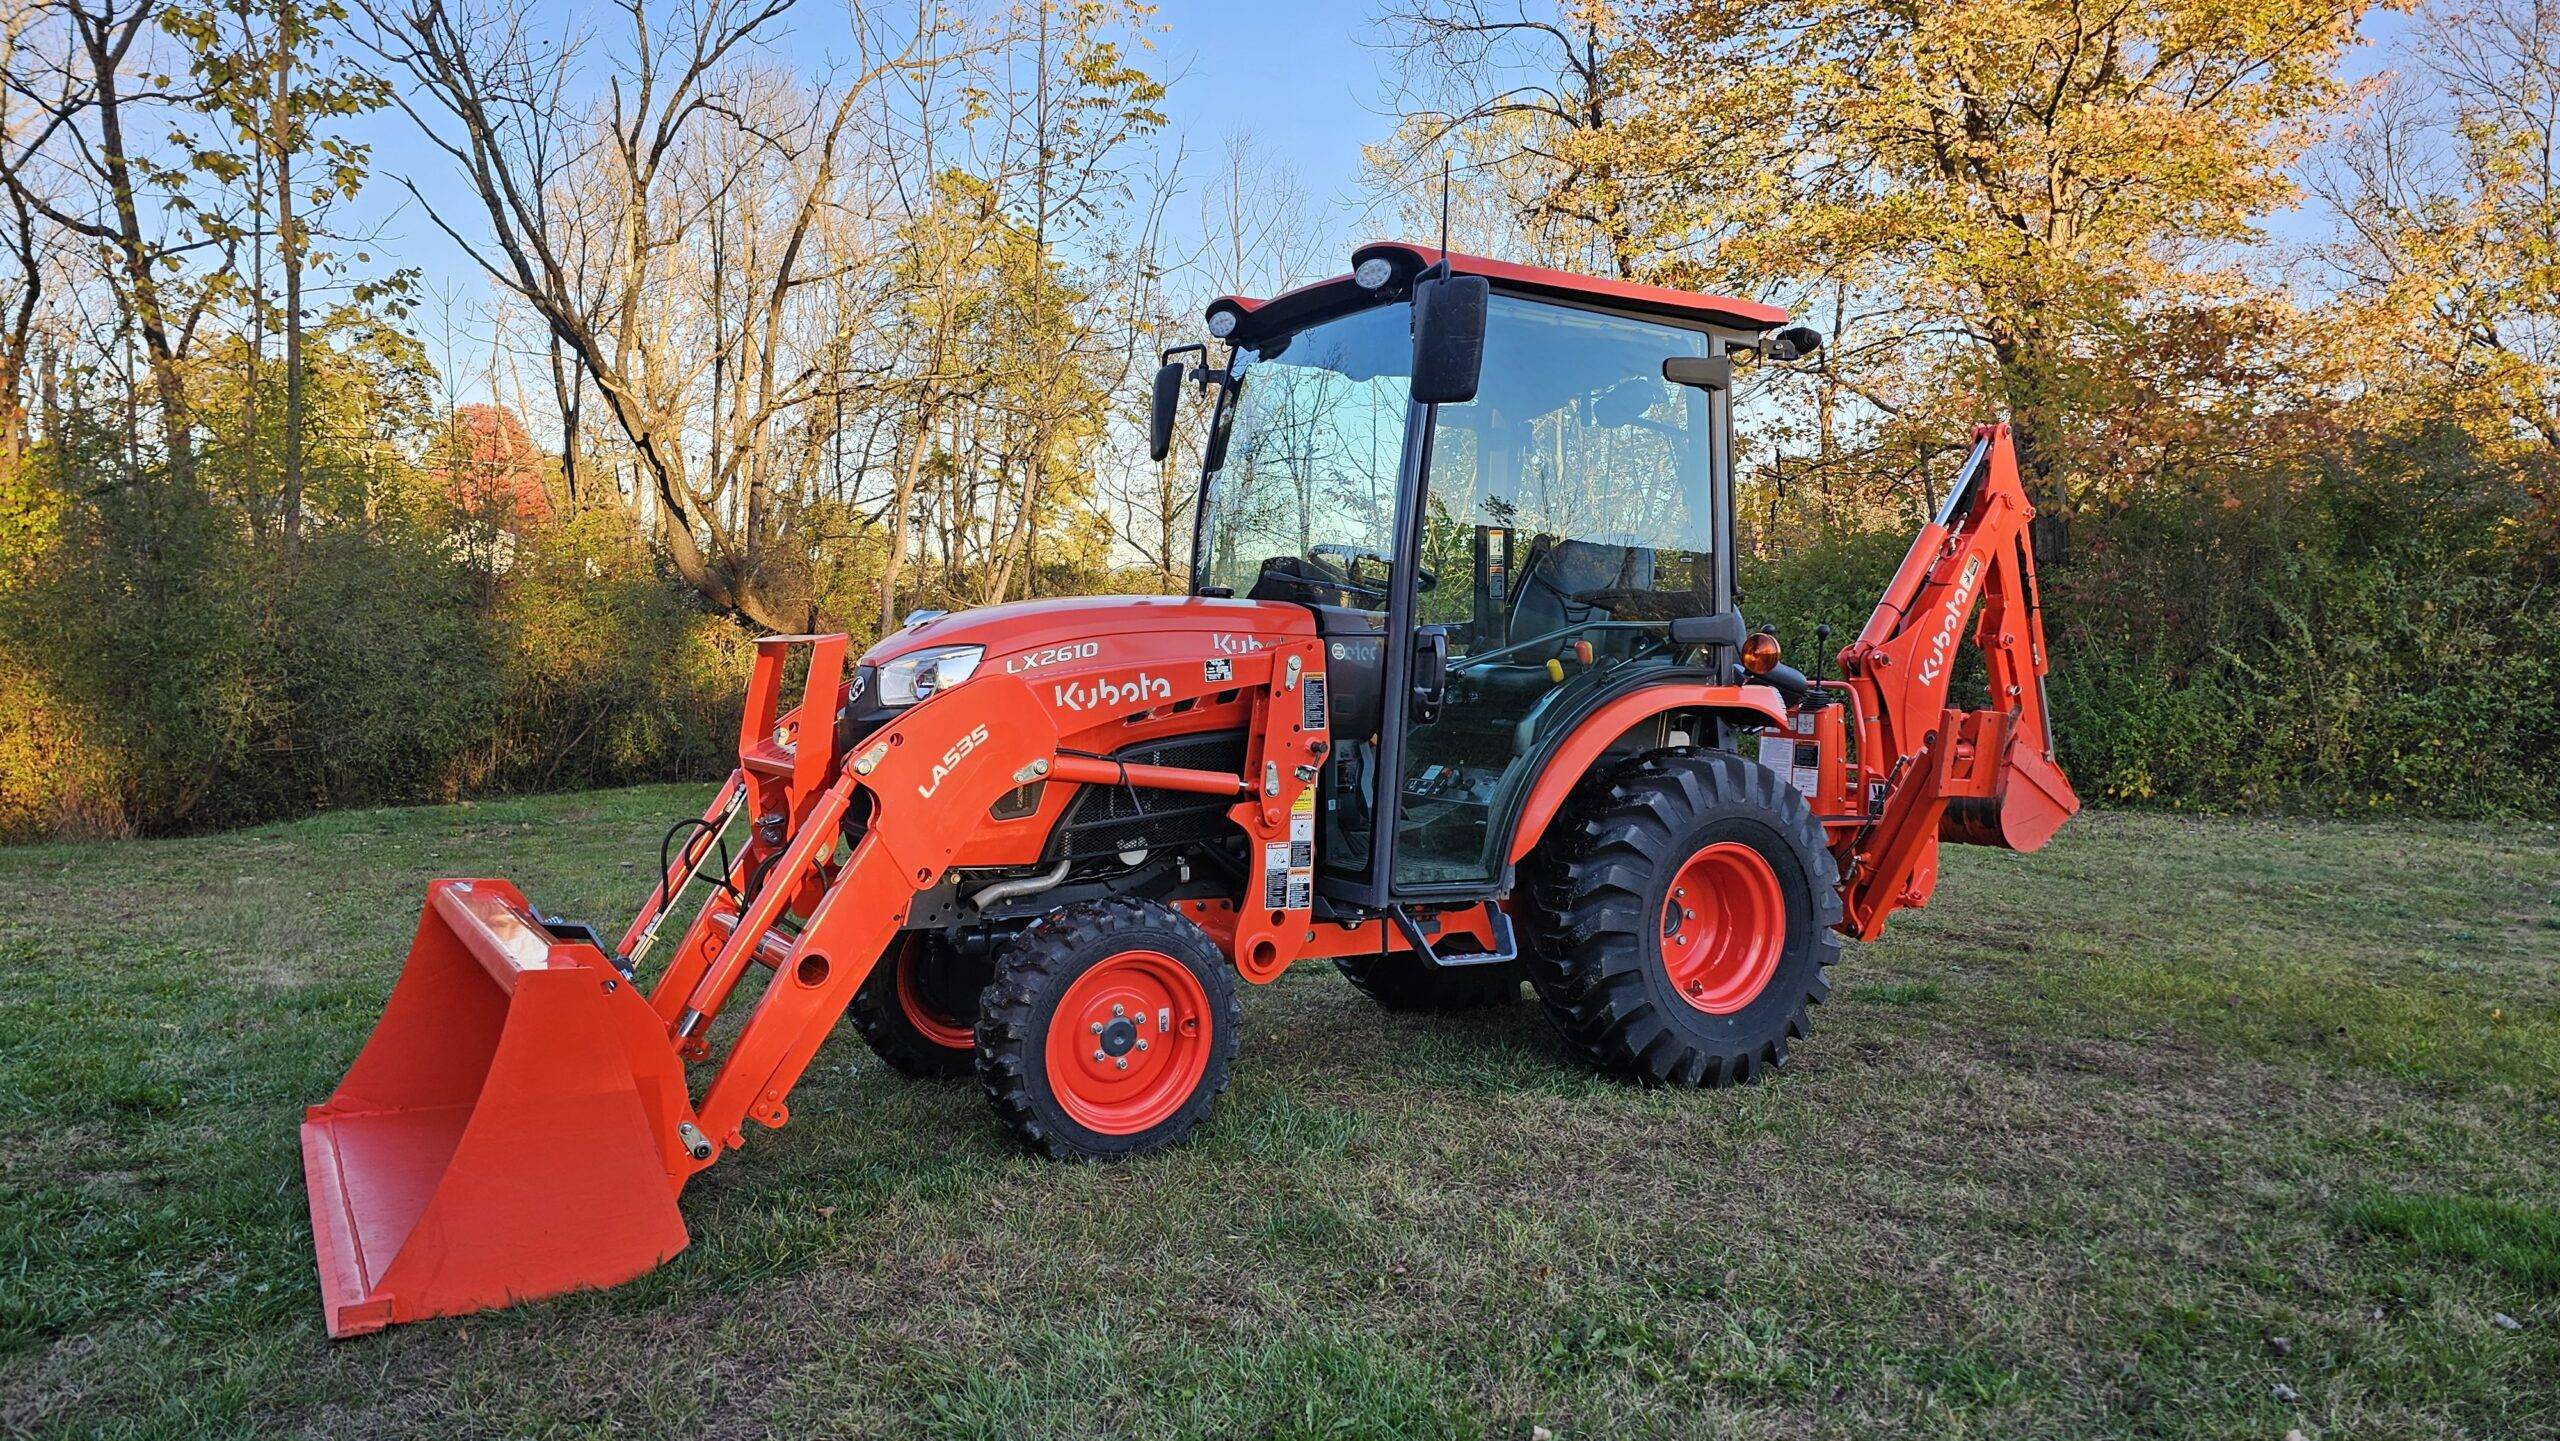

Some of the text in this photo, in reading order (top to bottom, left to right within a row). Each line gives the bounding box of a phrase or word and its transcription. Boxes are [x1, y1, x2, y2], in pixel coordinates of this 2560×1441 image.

[1213, 632, 1284, 655] Kub
[1918, 588, 1968, 686] Kubota
[1006, 642, 1098, 675] LX2610
[1055, 673, 1171, 711] Kubota
[918, 724, 989, 799] LA535
